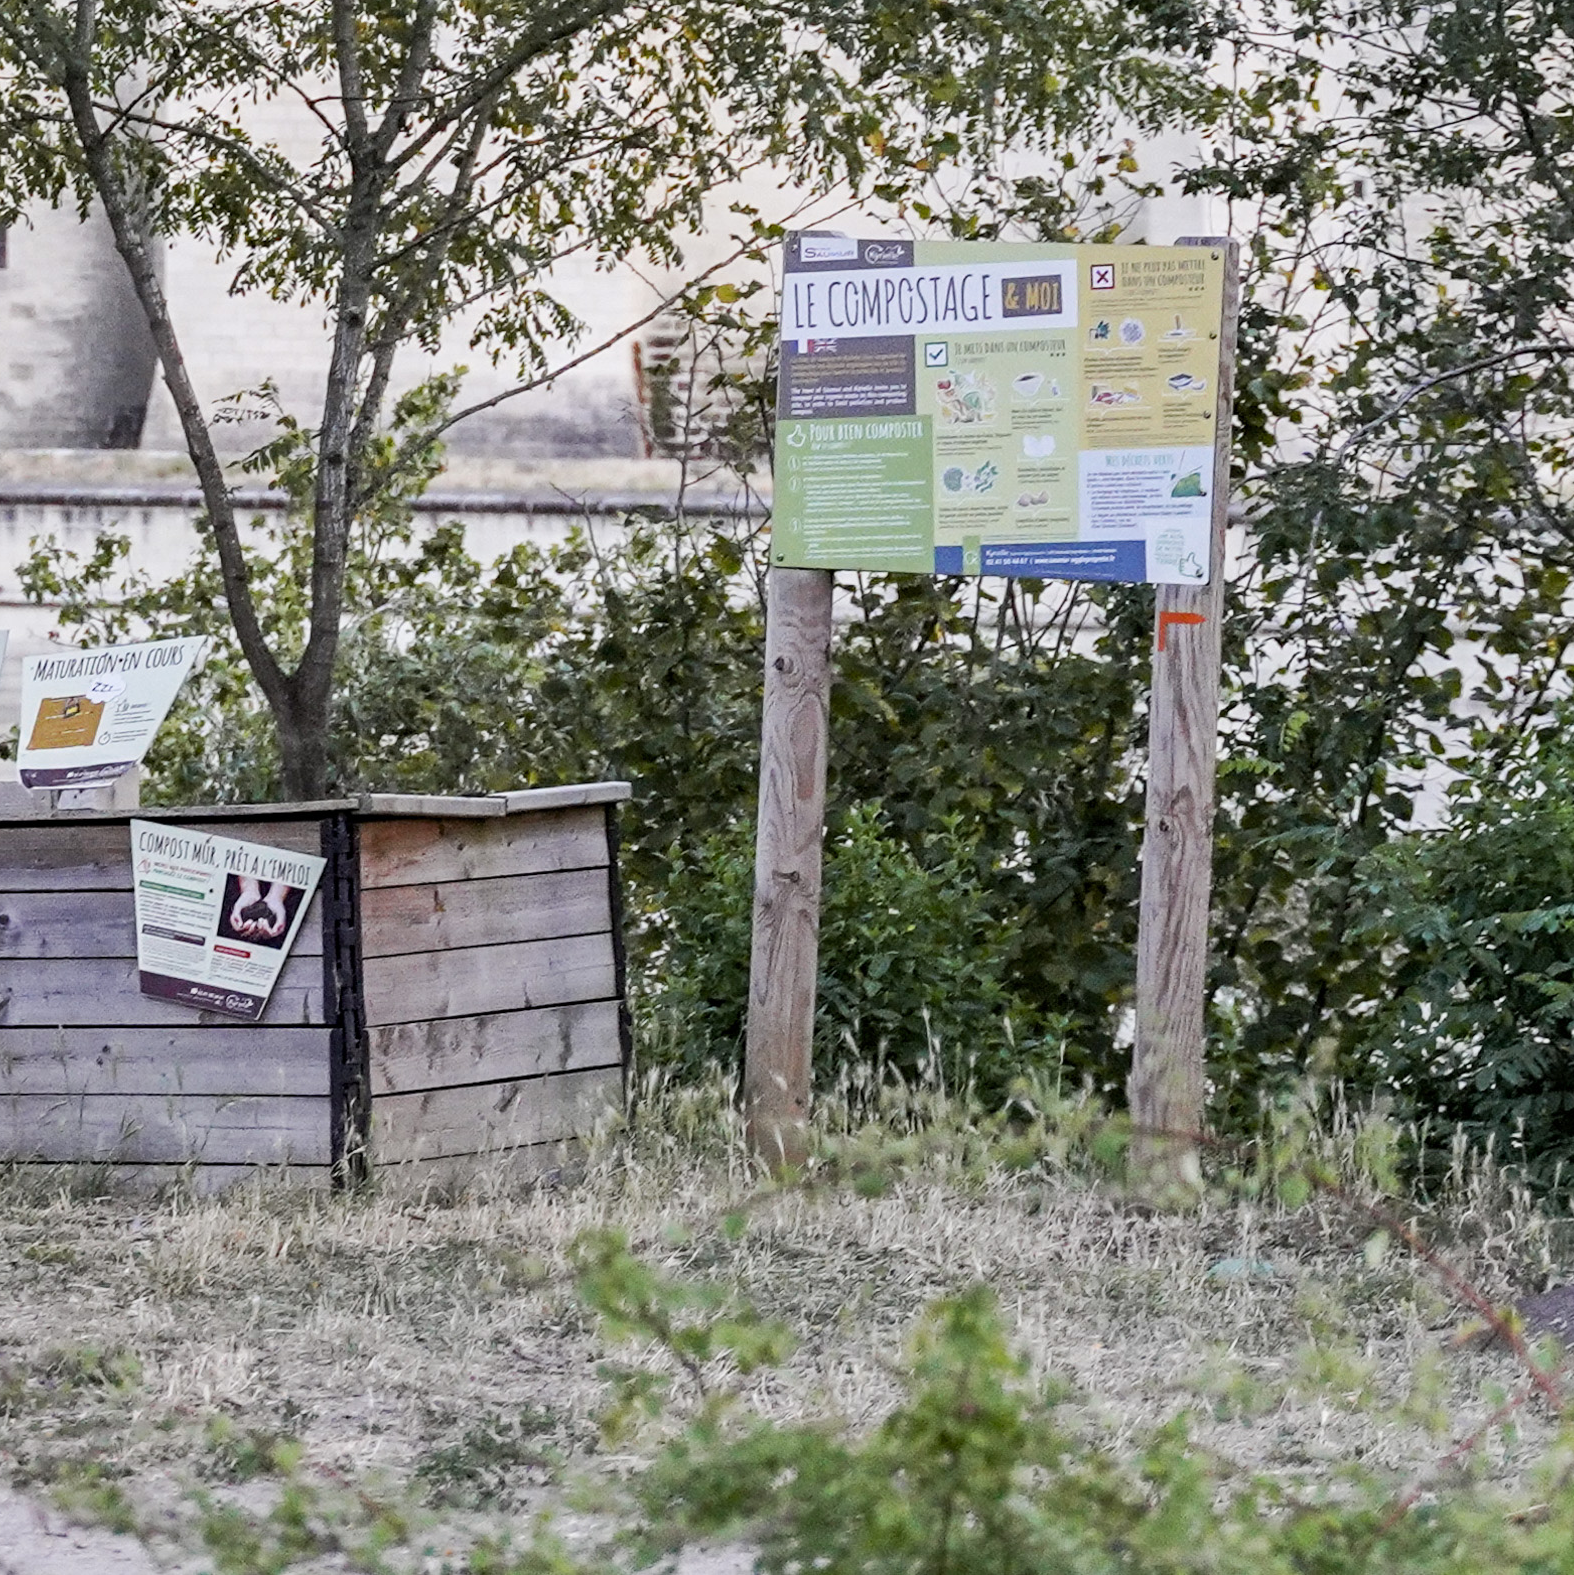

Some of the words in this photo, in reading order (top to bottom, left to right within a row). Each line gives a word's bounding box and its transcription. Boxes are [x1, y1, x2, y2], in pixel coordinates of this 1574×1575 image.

[794, 282, 818, 329] LE
[828, 274, 993, 328] COMPOSTAGE
[1004, 281, 1020, 310] &
[1026, 280, 1061, 311] MOI
[809, 423, 835, 442] POUR
[837, 423, 863, 441] BIEN
[865, 421, 924, 439] COMPOSTER
[33, 652, 119, 682] MATURATION
[121, 650, 142, 673] EN
[145, 645, 185, 669] COURS
[139, 831, 190, 859] COMPOST
[225, 846, 249, 873] PRÊT
[261, 857, 312, 886] L'EMPLOI
